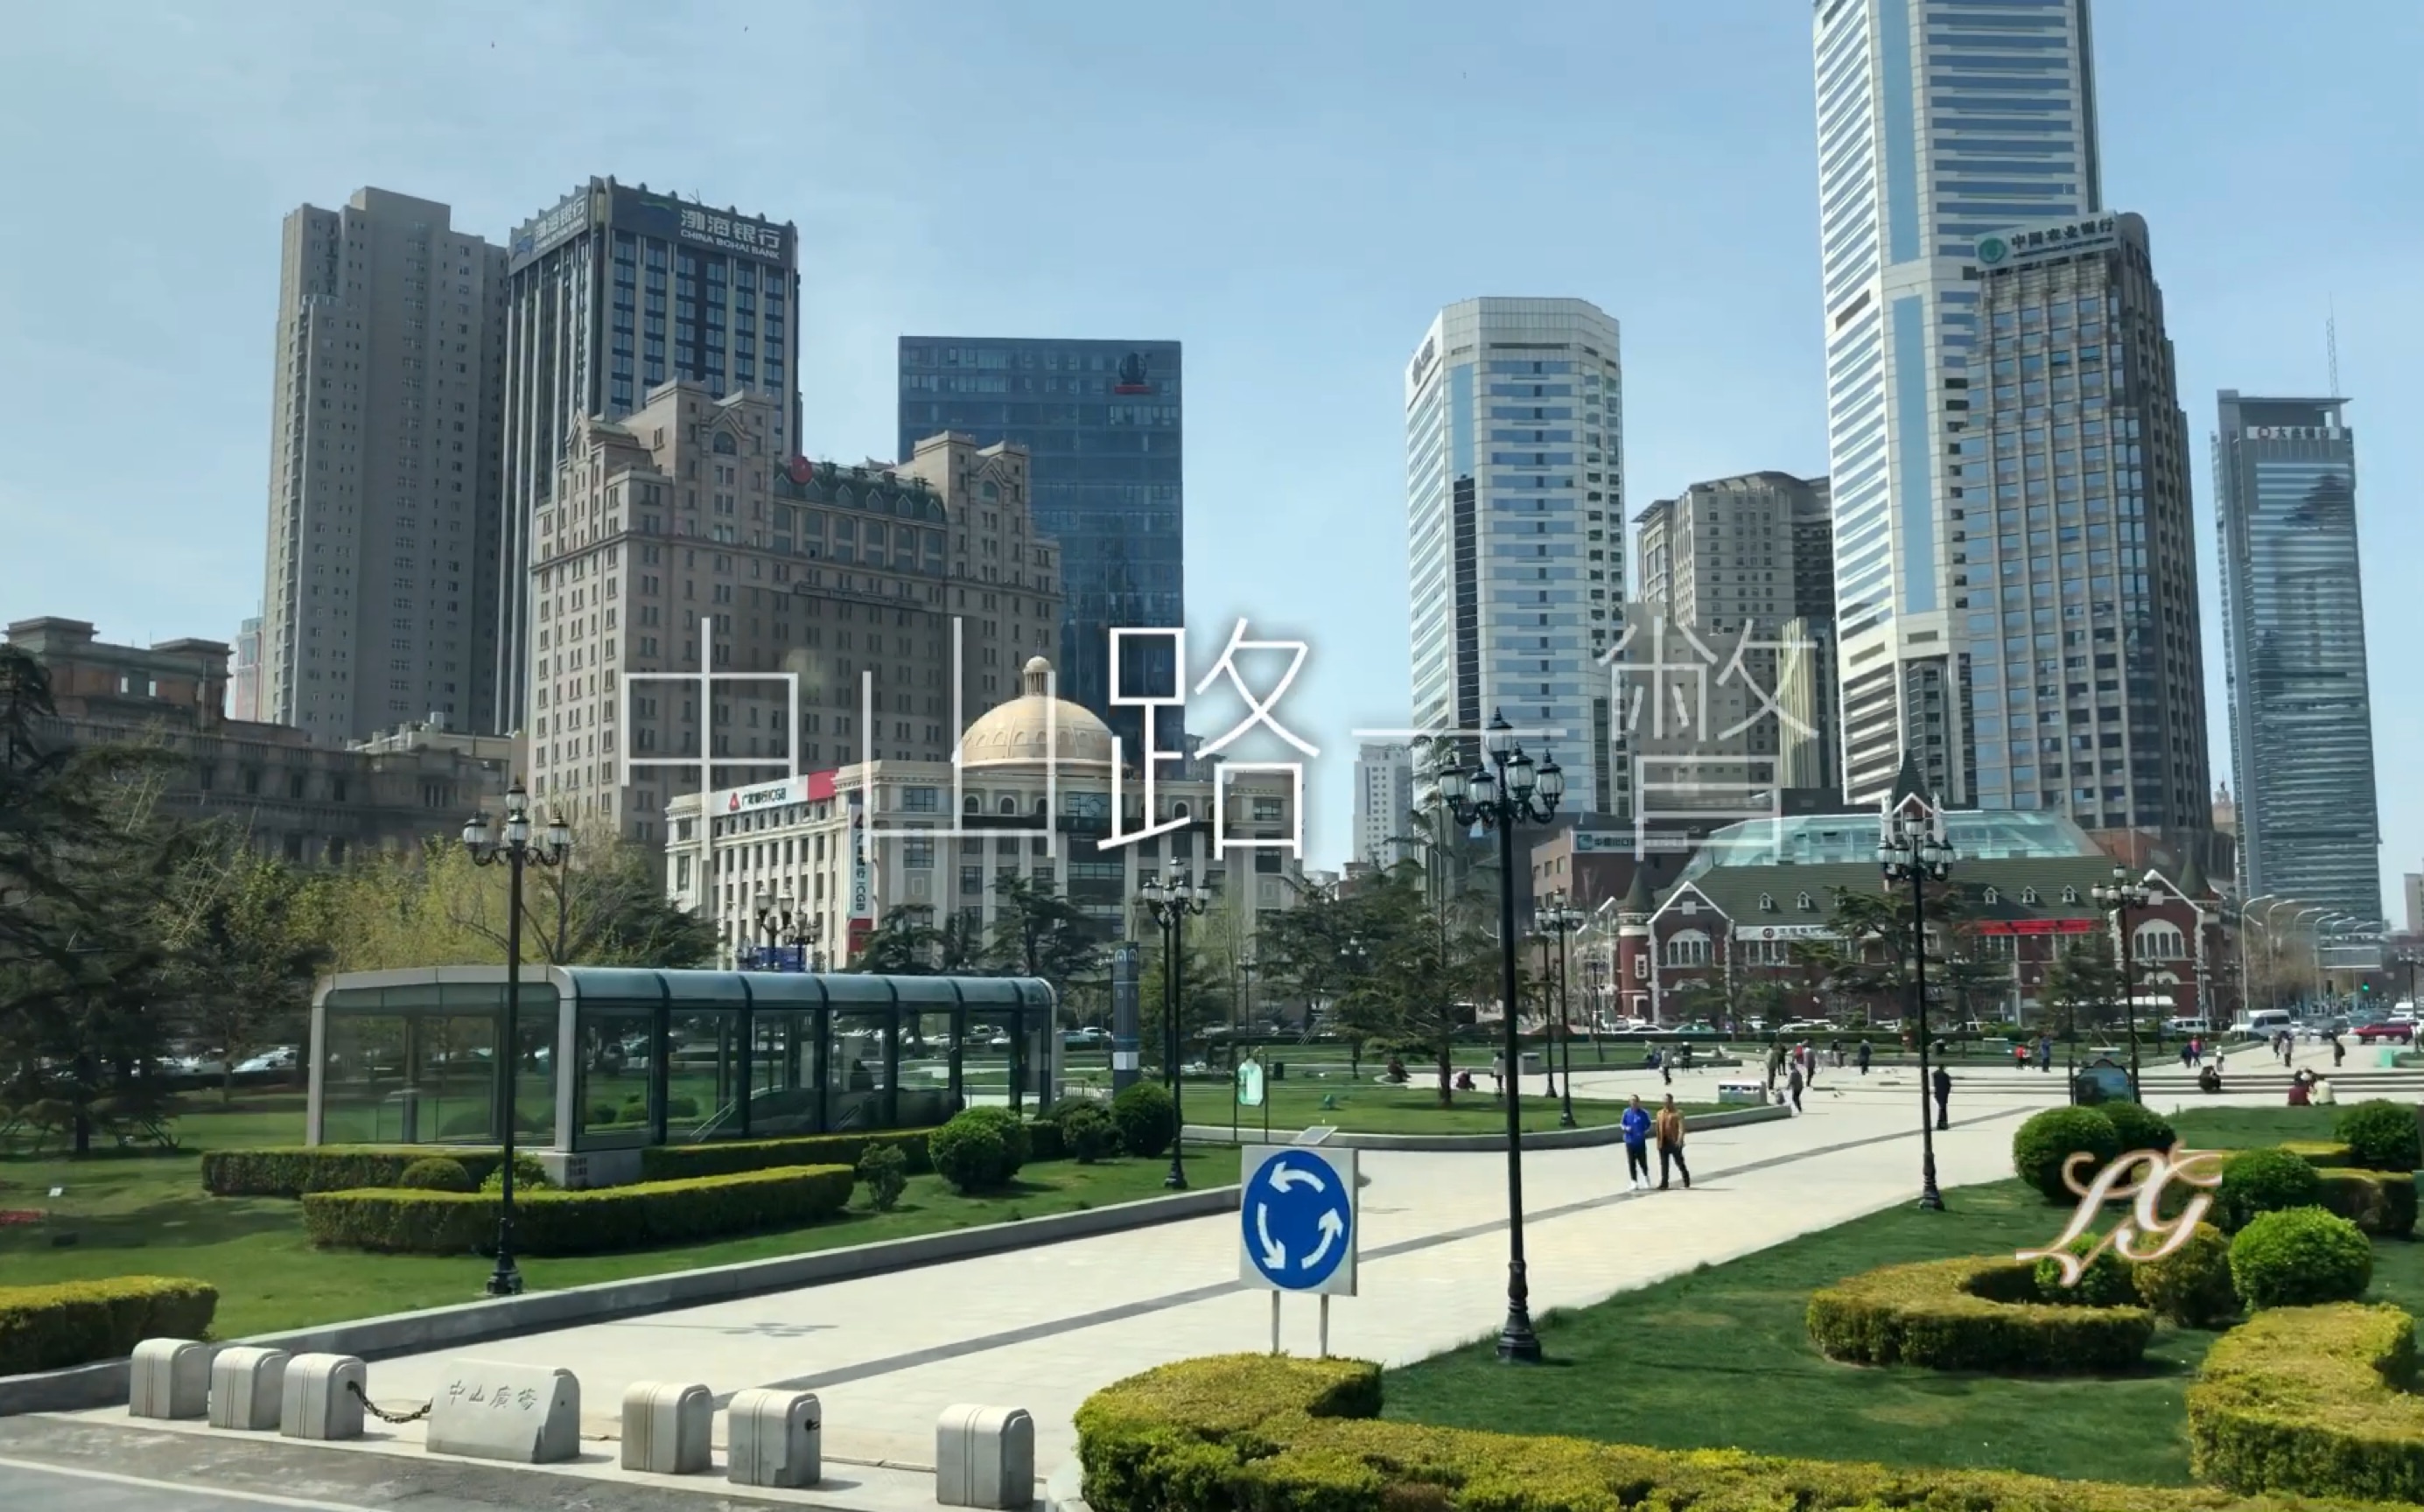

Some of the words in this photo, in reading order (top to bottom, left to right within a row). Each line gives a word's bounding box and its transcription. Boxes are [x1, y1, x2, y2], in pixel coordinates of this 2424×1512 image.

[680, 228, 714, 245] CHINA
[716, 237, 750, 254] BOHAI
[751, 246, 781, 261] BANK
[681, 208, 781, 249] 渤海银行
[2011, 217, 2114, 249] 中国农业银行
